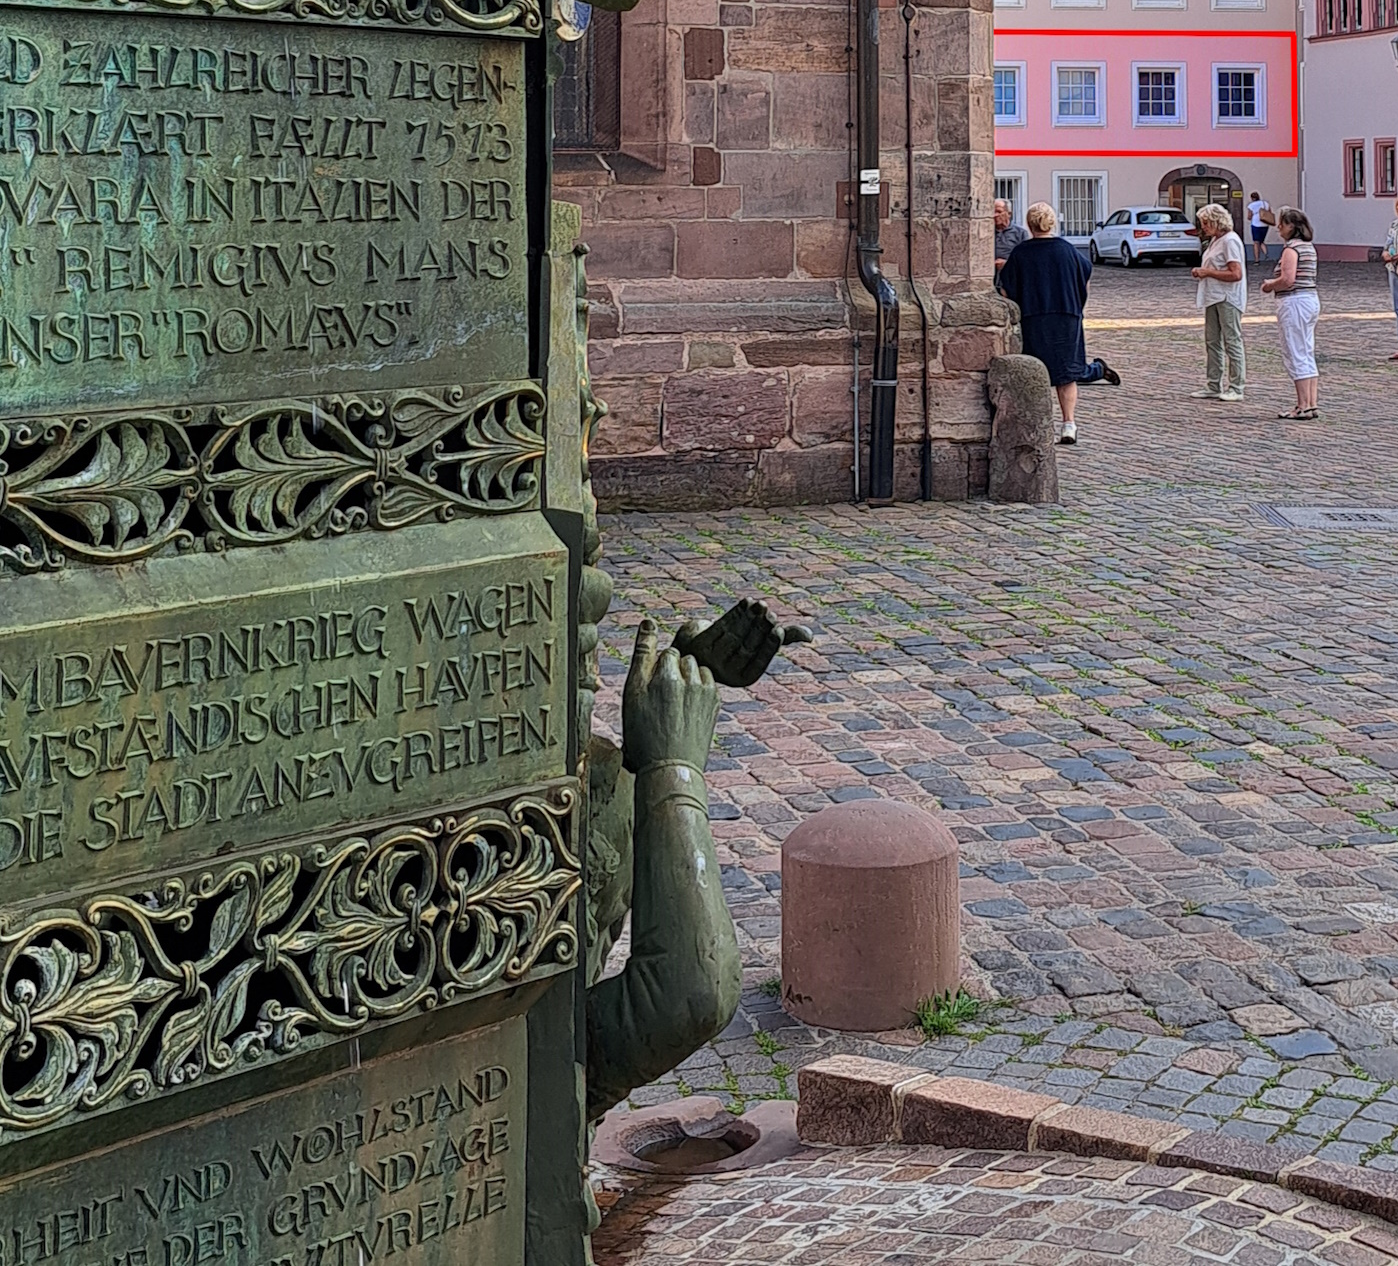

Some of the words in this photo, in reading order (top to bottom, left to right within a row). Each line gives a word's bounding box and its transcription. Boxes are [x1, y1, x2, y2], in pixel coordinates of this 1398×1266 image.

[58, 39, 373, 100] ZAHLREICHER
[389, 58, 517, 110] LEGEN-
[185, 176, 236, 223] IN
[250, 175, 421, 224] ITALIEN
[442, 178, 515, 222] DER
[55, 240, 338, 297] REMIGIVS
[364, 236, 513, 284] MANS
[53, 605, 391, 710] BAVERNKRIEG
[403, 576, 555, 645] WAGEN
[394, 639, 554, 714] HAVFEN
[78, 771, 231, 851] STADT
[134, 1161, 233, 1220] VND
[251, 1066, 511, 1180] WOHLSTAND
[267, 1114, 511, 1237] GRVNDLAGE
